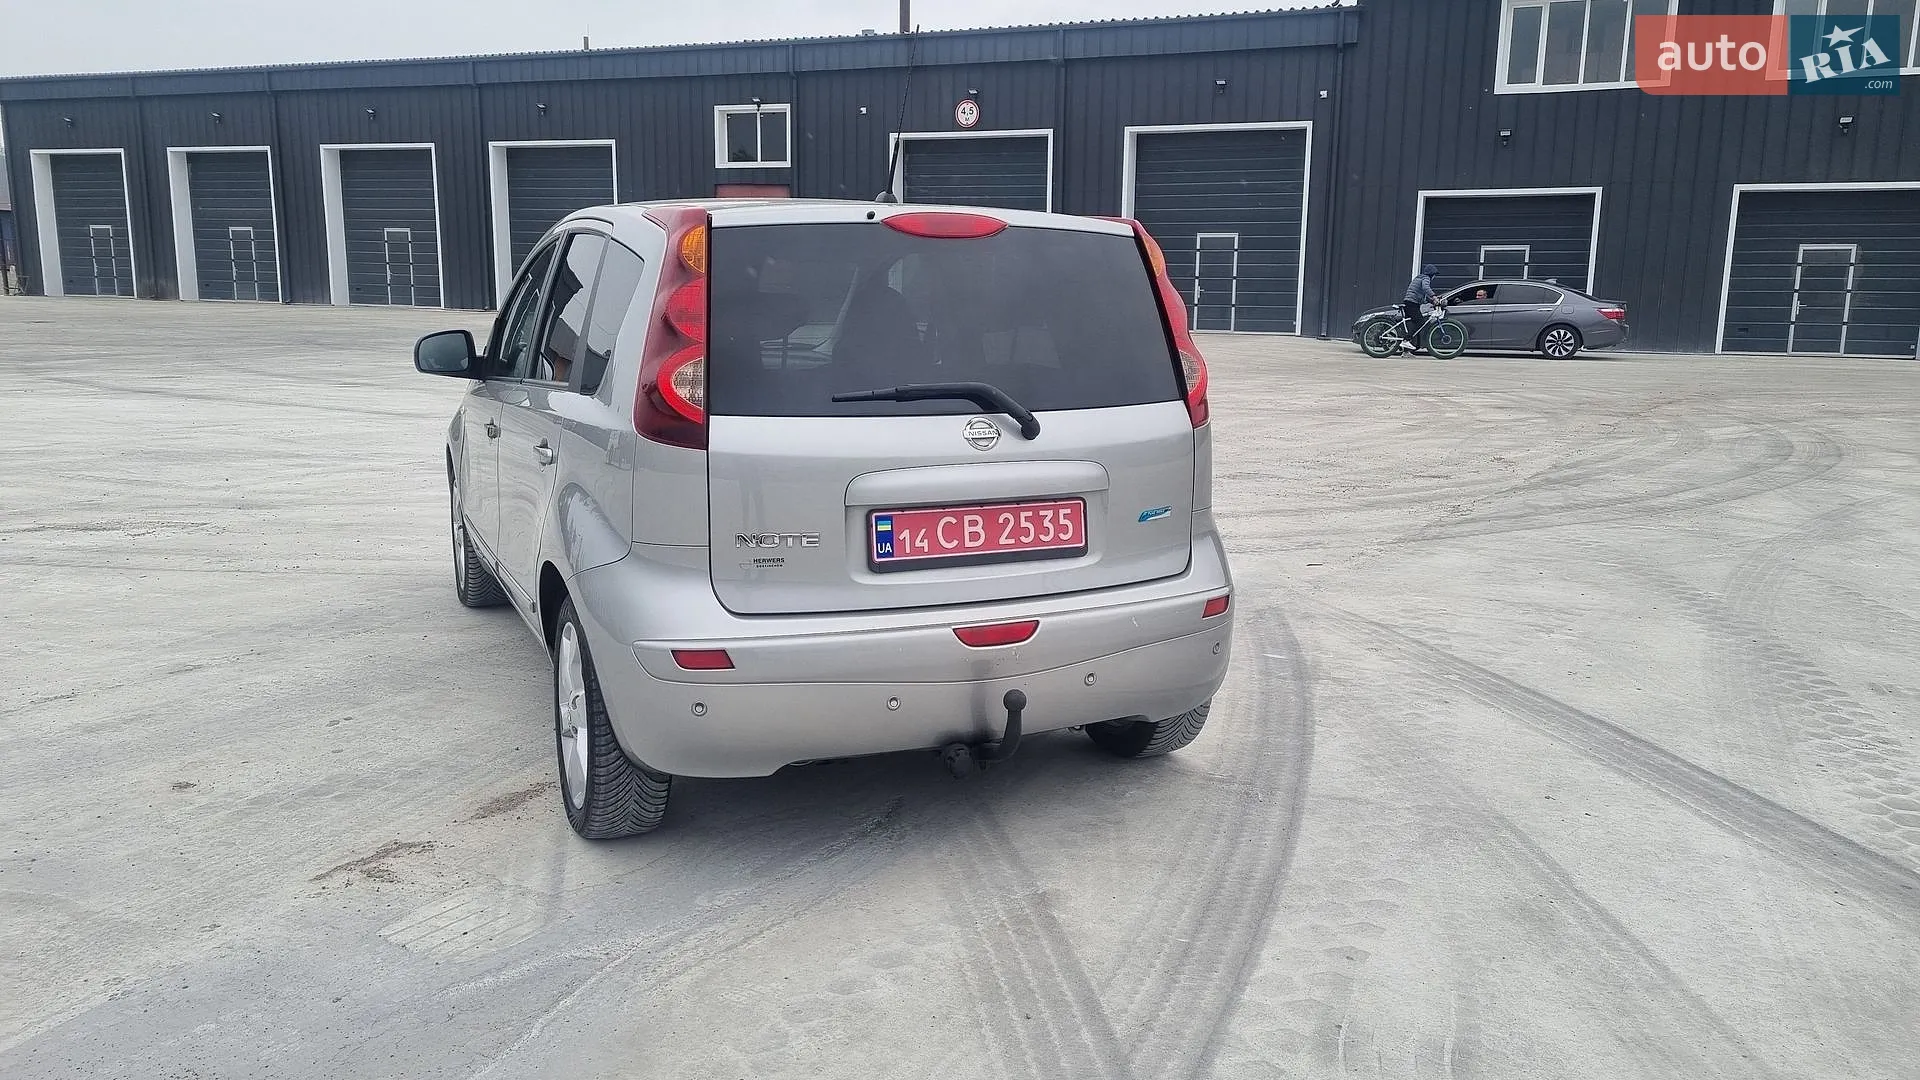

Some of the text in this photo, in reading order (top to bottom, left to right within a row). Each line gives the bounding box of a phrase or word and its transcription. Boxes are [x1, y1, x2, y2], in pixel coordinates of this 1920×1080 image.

[961, 106, 974, 117] 4,5
[898, 528, 929, 553] 14
[998, 508, 1074, 545] 2535
[735, 532, 820, 548] NOTE
[877, 544, 893, 554] UA
